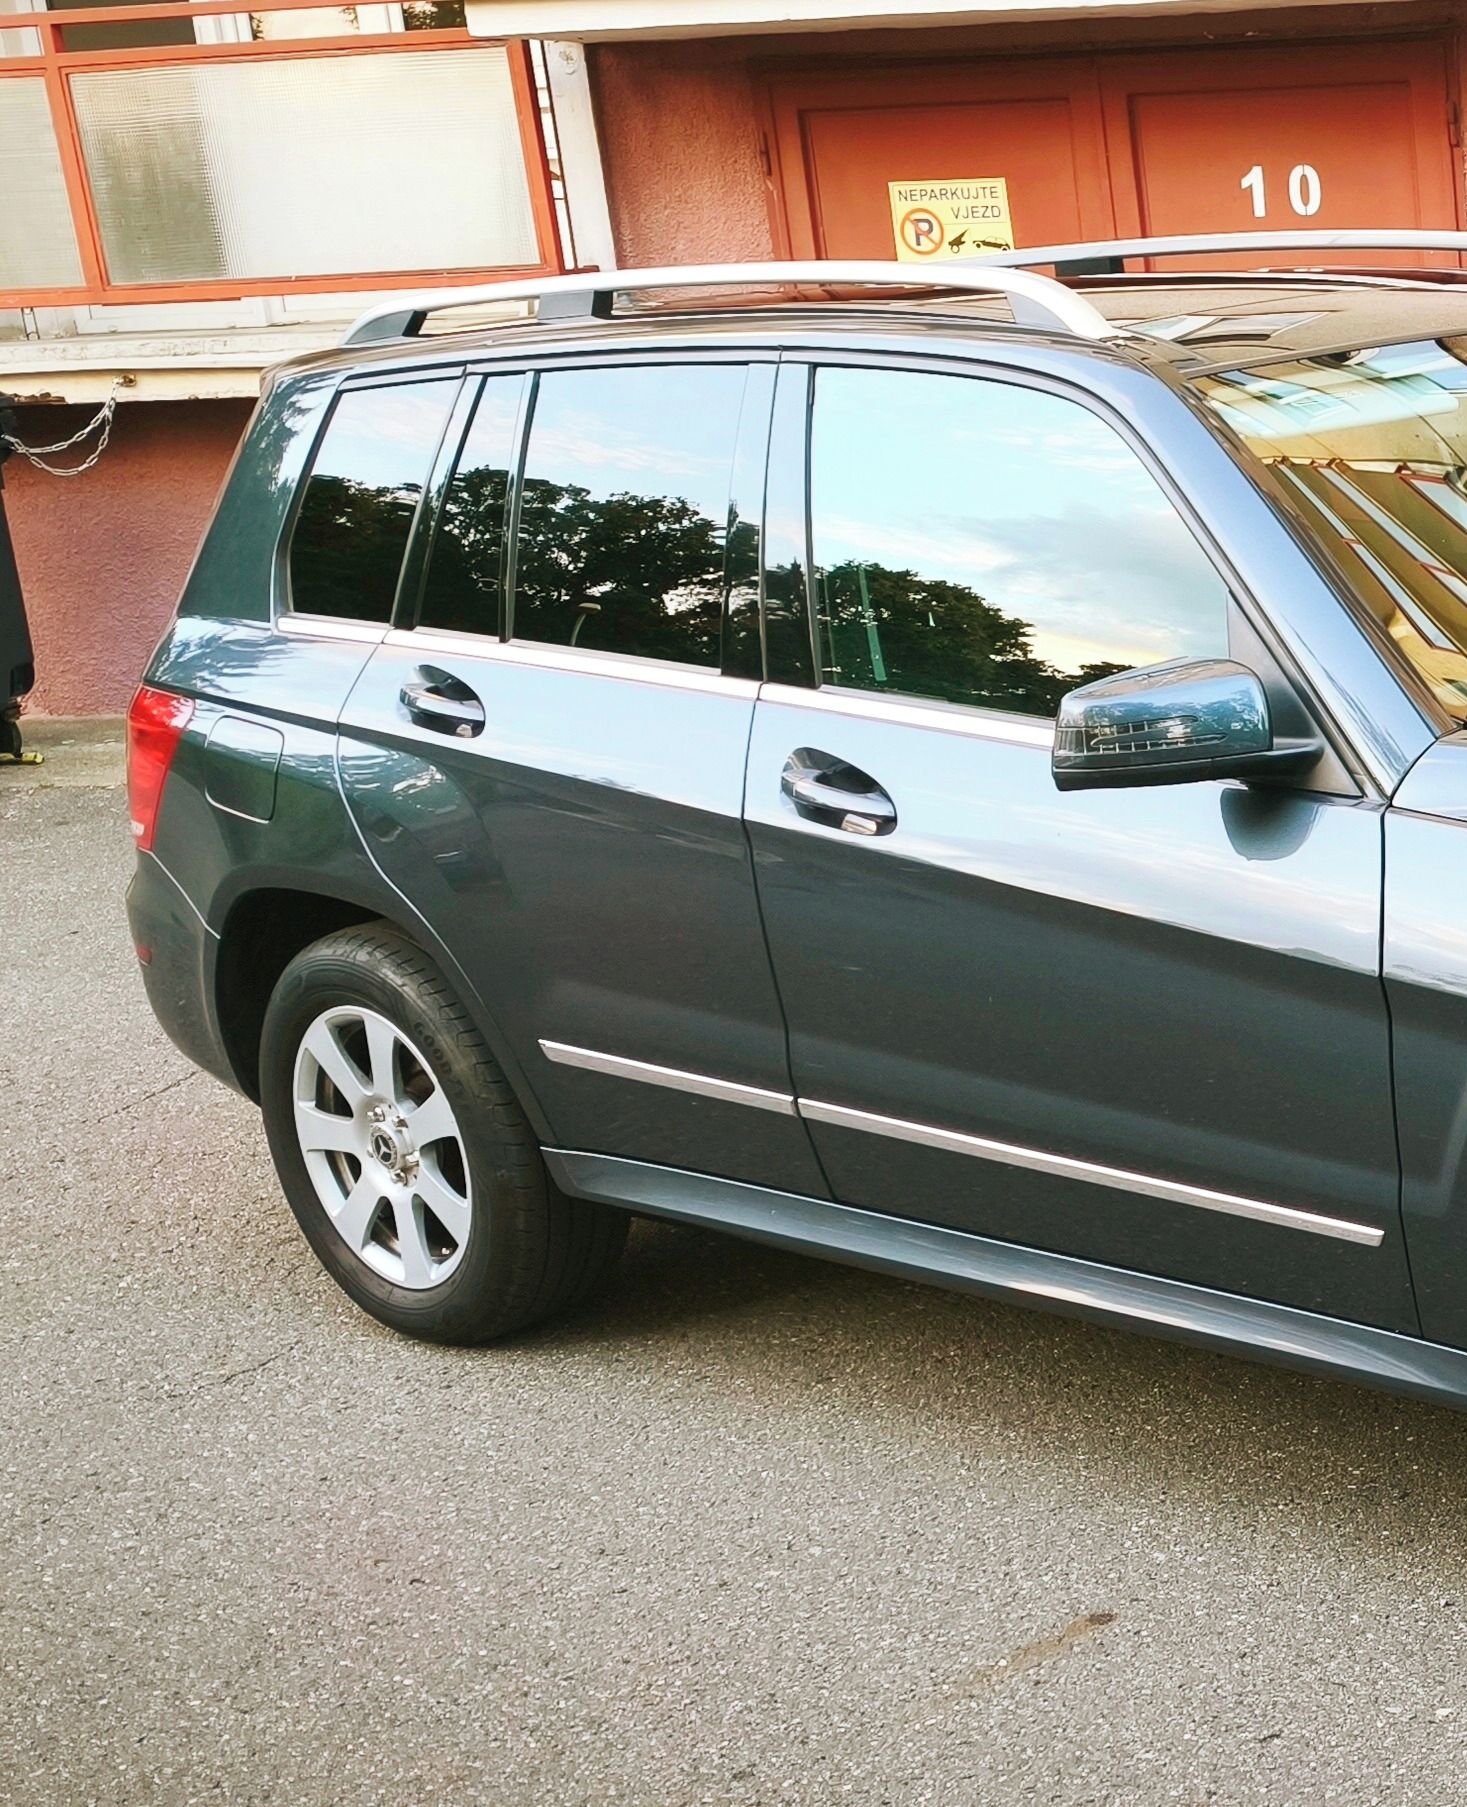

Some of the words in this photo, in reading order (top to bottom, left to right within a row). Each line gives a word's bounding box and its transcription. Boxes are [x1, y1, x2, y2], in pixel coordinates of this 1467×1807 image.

[898, 186, 999, 202] NEPARKUJTE
[1240, 164, 1321, 218] 10
[951, 205, 1001, 219] VJEZD
